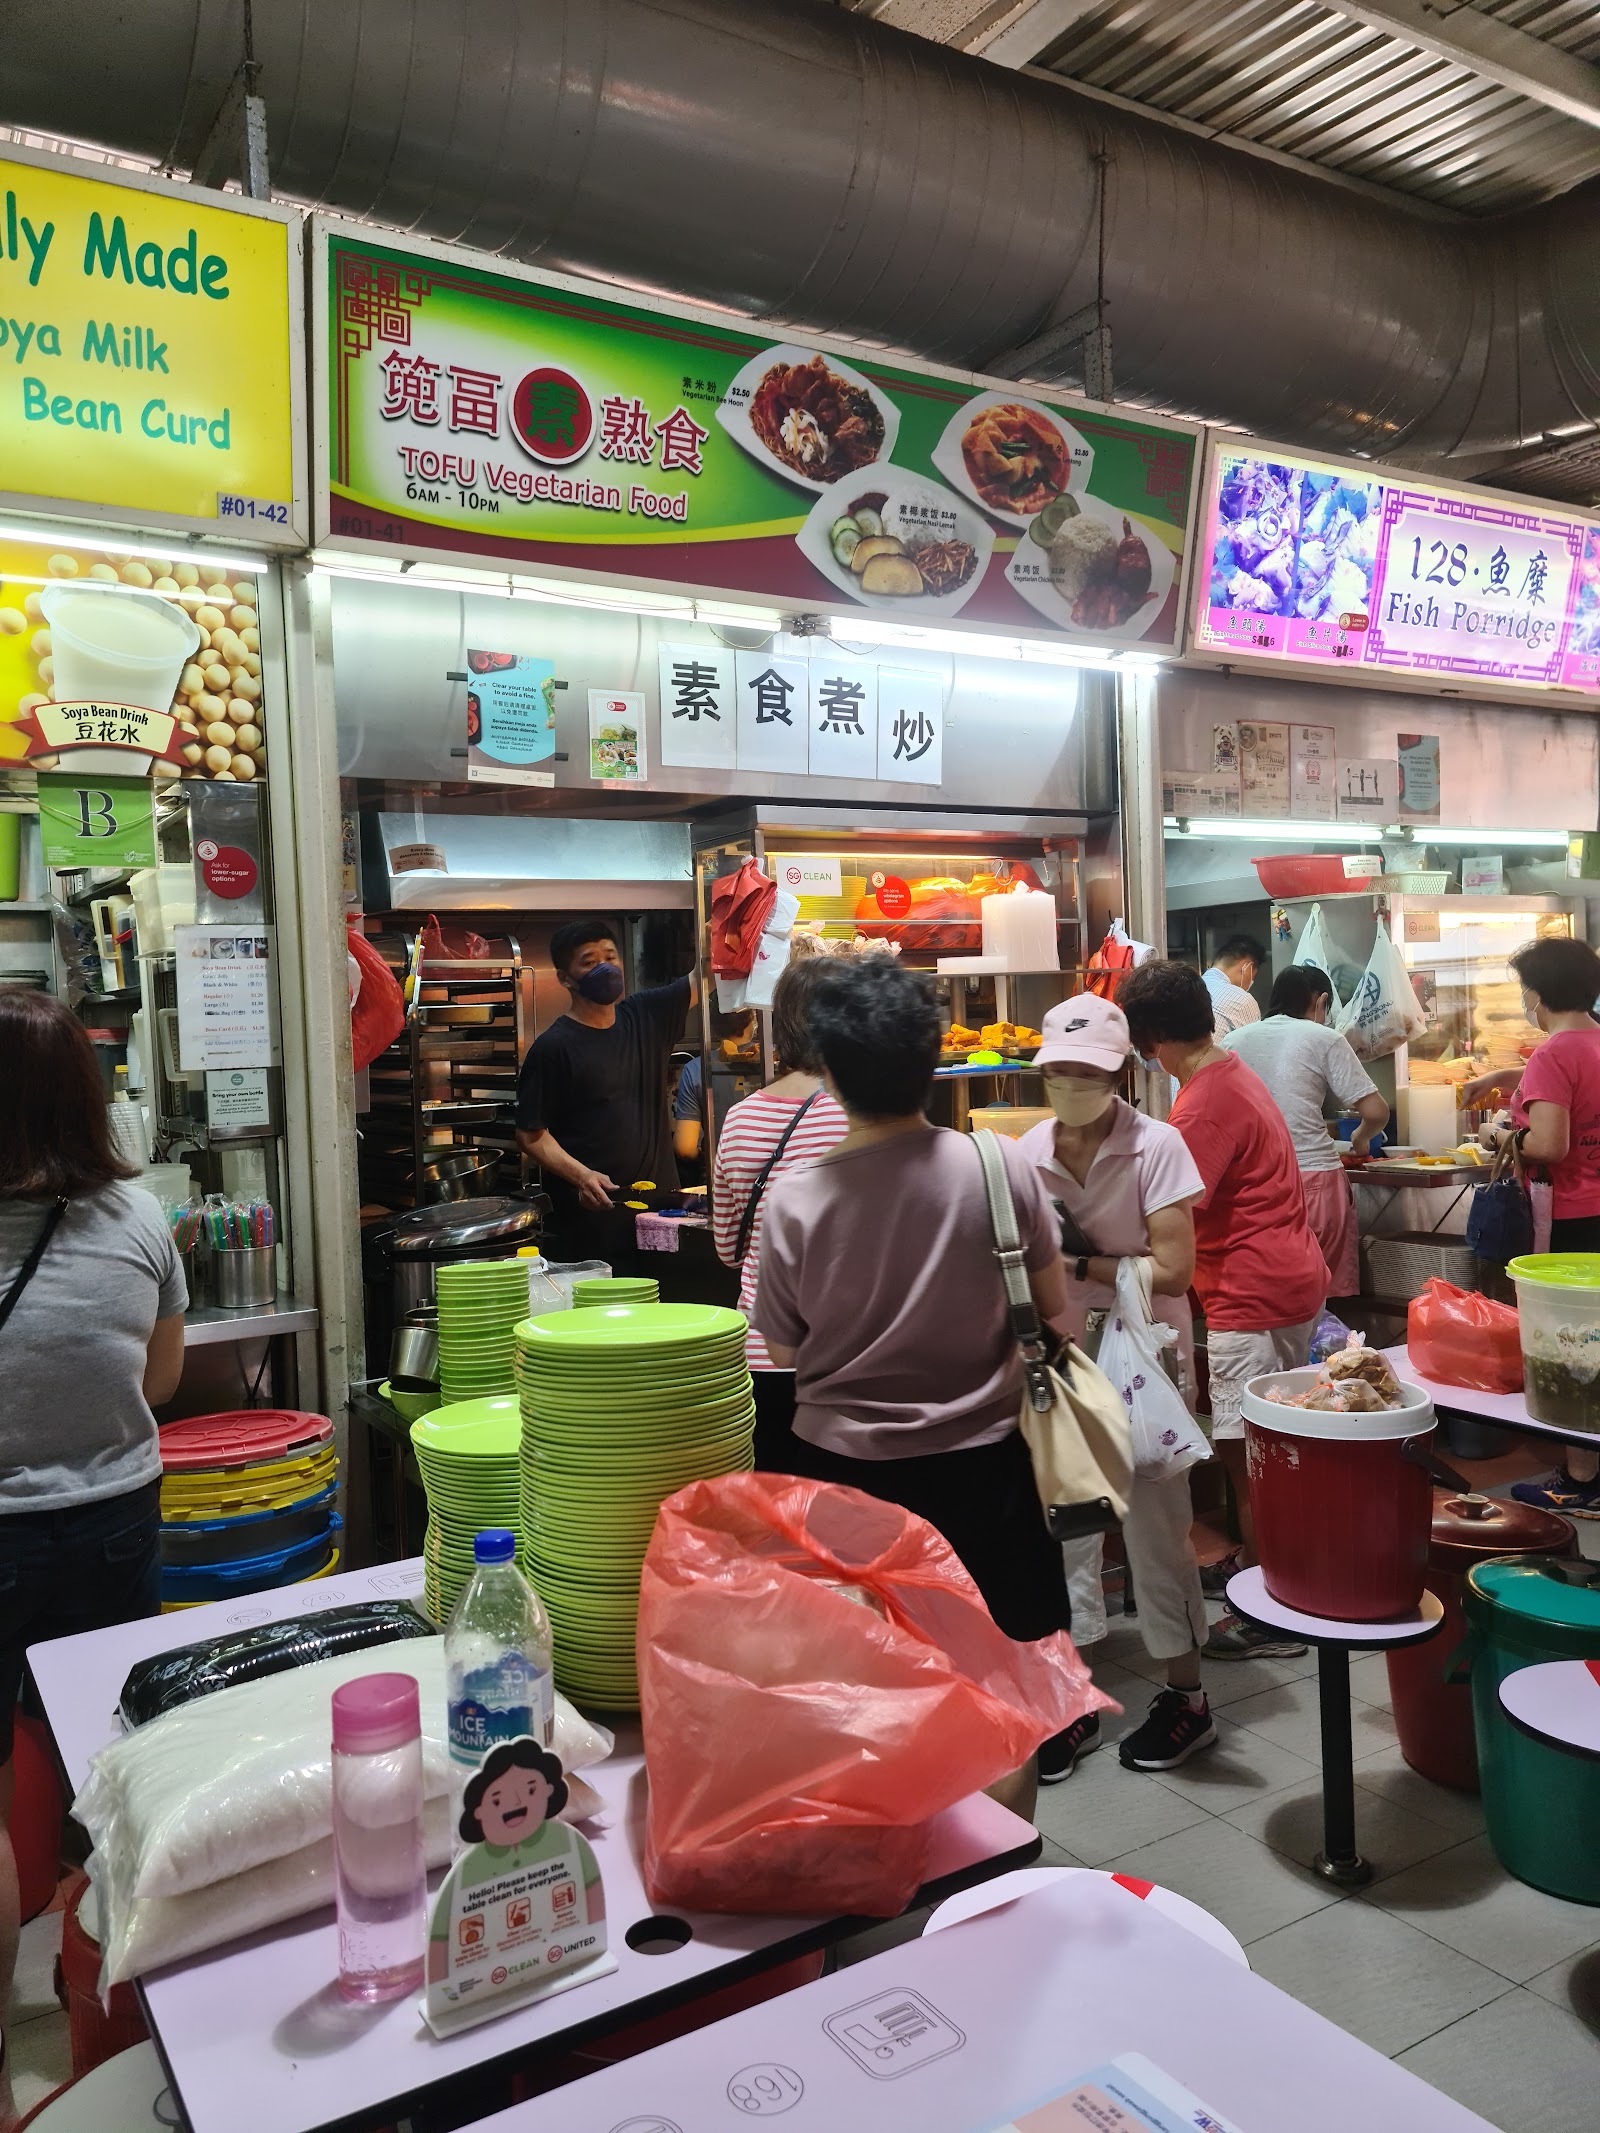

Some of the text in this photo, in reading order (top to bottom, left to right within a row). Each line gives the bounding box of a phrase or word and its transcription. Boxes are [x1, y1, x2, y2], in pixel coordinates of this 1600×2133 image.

[0, 191, 230, 300] ly Made
[83, 320, 169, 374] Milk
[682, 389, 714, 402] Vegetarian
[728, 398, 744, 407] Hoon
[732, 387, 750, 397] $2.50
[23, 377, 230, 450] Bean Curd
[401, 446, 686, 518] TOFU Vegetarian Food
[406, 482, 440, 504] 6AM
[458, 490, 500, 513] 10PM
[221, 496, 288, 524] #01-42
[899, 516, 926, 526] Vegetarian
[338, 516, 405, 541] #01-41
[1013, 575, 1037, 583] Vegetarian
[1386, 592, 1556, 650] Fish Porridge
[61, 704, 149, 725] Soya Bean Drink
[671, 661, 935, 762] 素食煮炒
[75, 720, 141, 744] 豆花水
[73, 789, 118, 838] B
[211, 868, 249, 877] lower-sugar
[803, 872, 832, 881] CLEAN
[460, 1714, 486, 1733] ICE
[463, 1871, 571, 1913] table clean for everyone.
[468, 1862, 565, 1901] Hello! Please keep the
[508, 1957, 540, 1974] CLEAN
[564, 1936, 596, 1954] UNITED
[732, 2068, 798, 2111] 168
